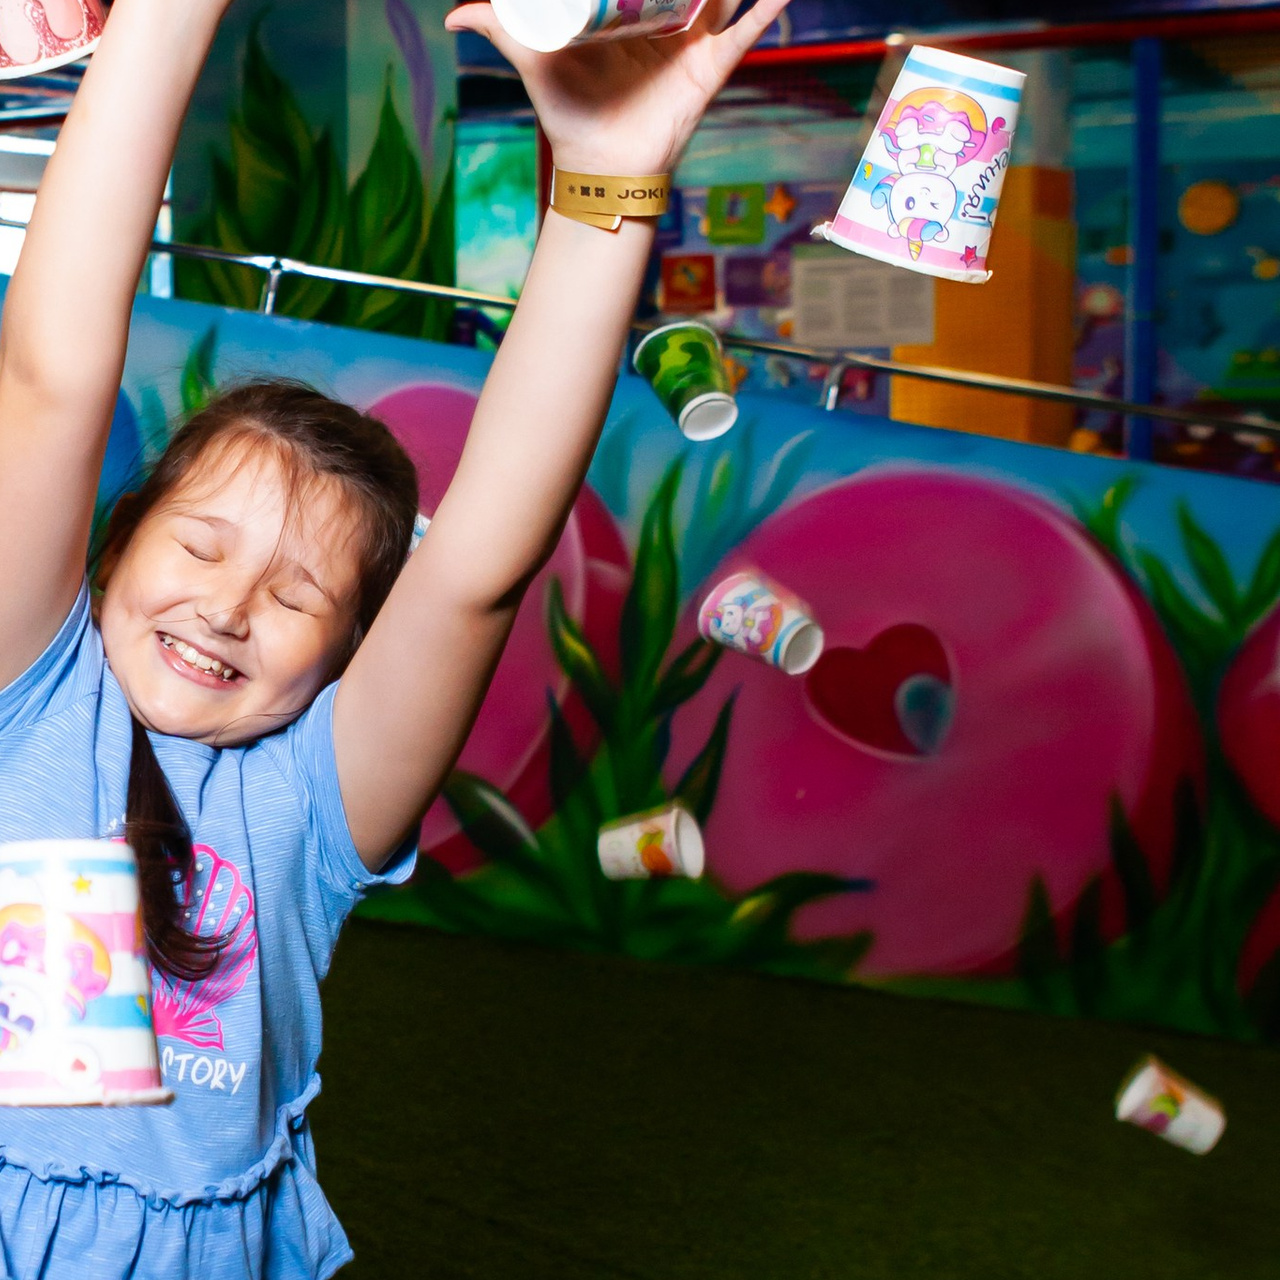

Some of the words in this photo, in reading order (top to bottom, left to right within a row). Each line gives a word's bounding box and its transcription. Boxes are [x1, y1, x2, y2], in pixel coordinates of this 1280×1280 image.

[617, 187, 664, 200] JOKI
[961, 132, 1013, 221] ения!
[160, 1045, 247, 1095] STORY
